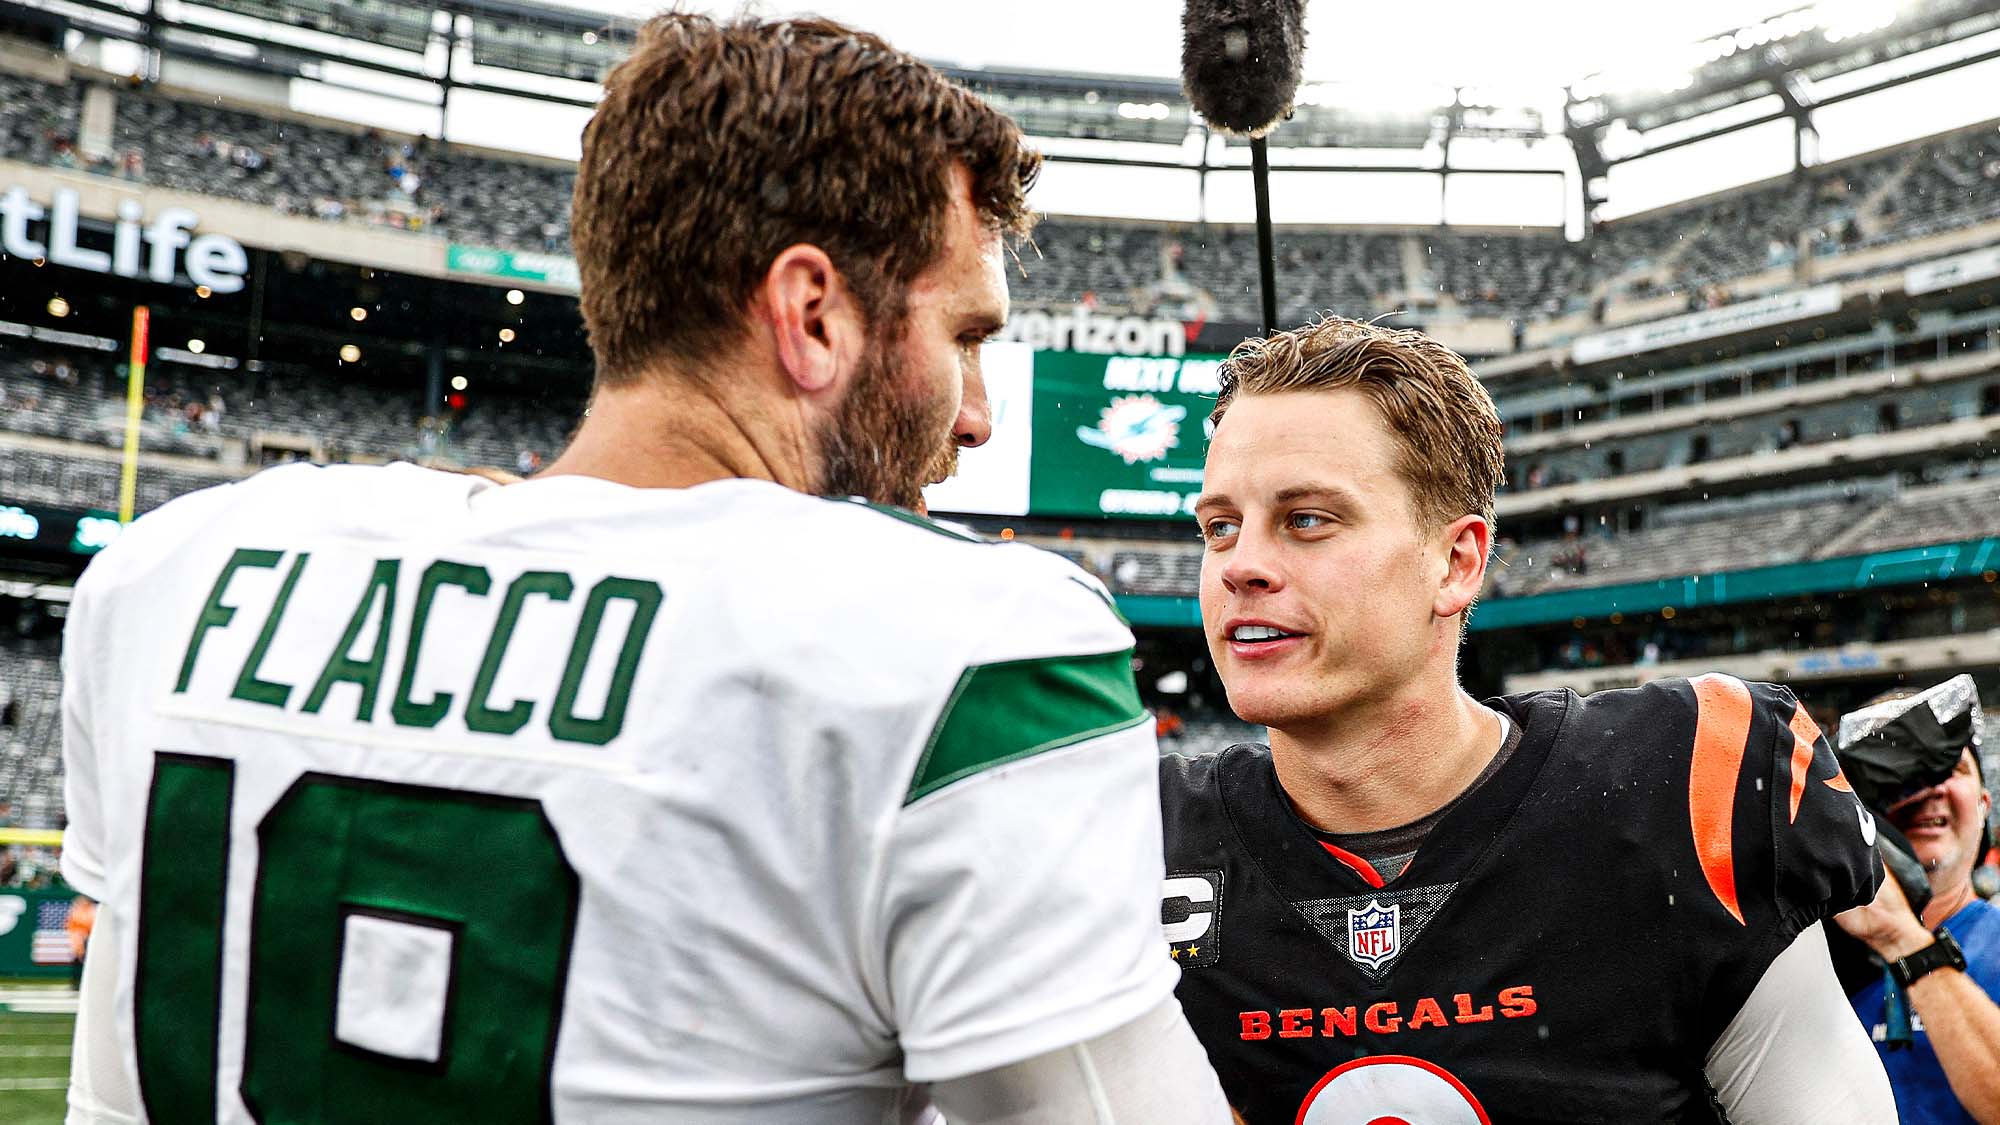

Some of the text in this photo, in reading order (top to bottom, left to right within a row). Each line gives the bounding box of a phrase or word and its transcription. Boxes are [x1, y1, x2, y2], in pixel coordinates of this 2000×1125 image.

[0, 184, 249, 294] tLife
[173, 547, 664, 746] FLACCO
[1356, 929, 1392, 957] NFL
[1239, 985, 1538, 1041] BENGALS
